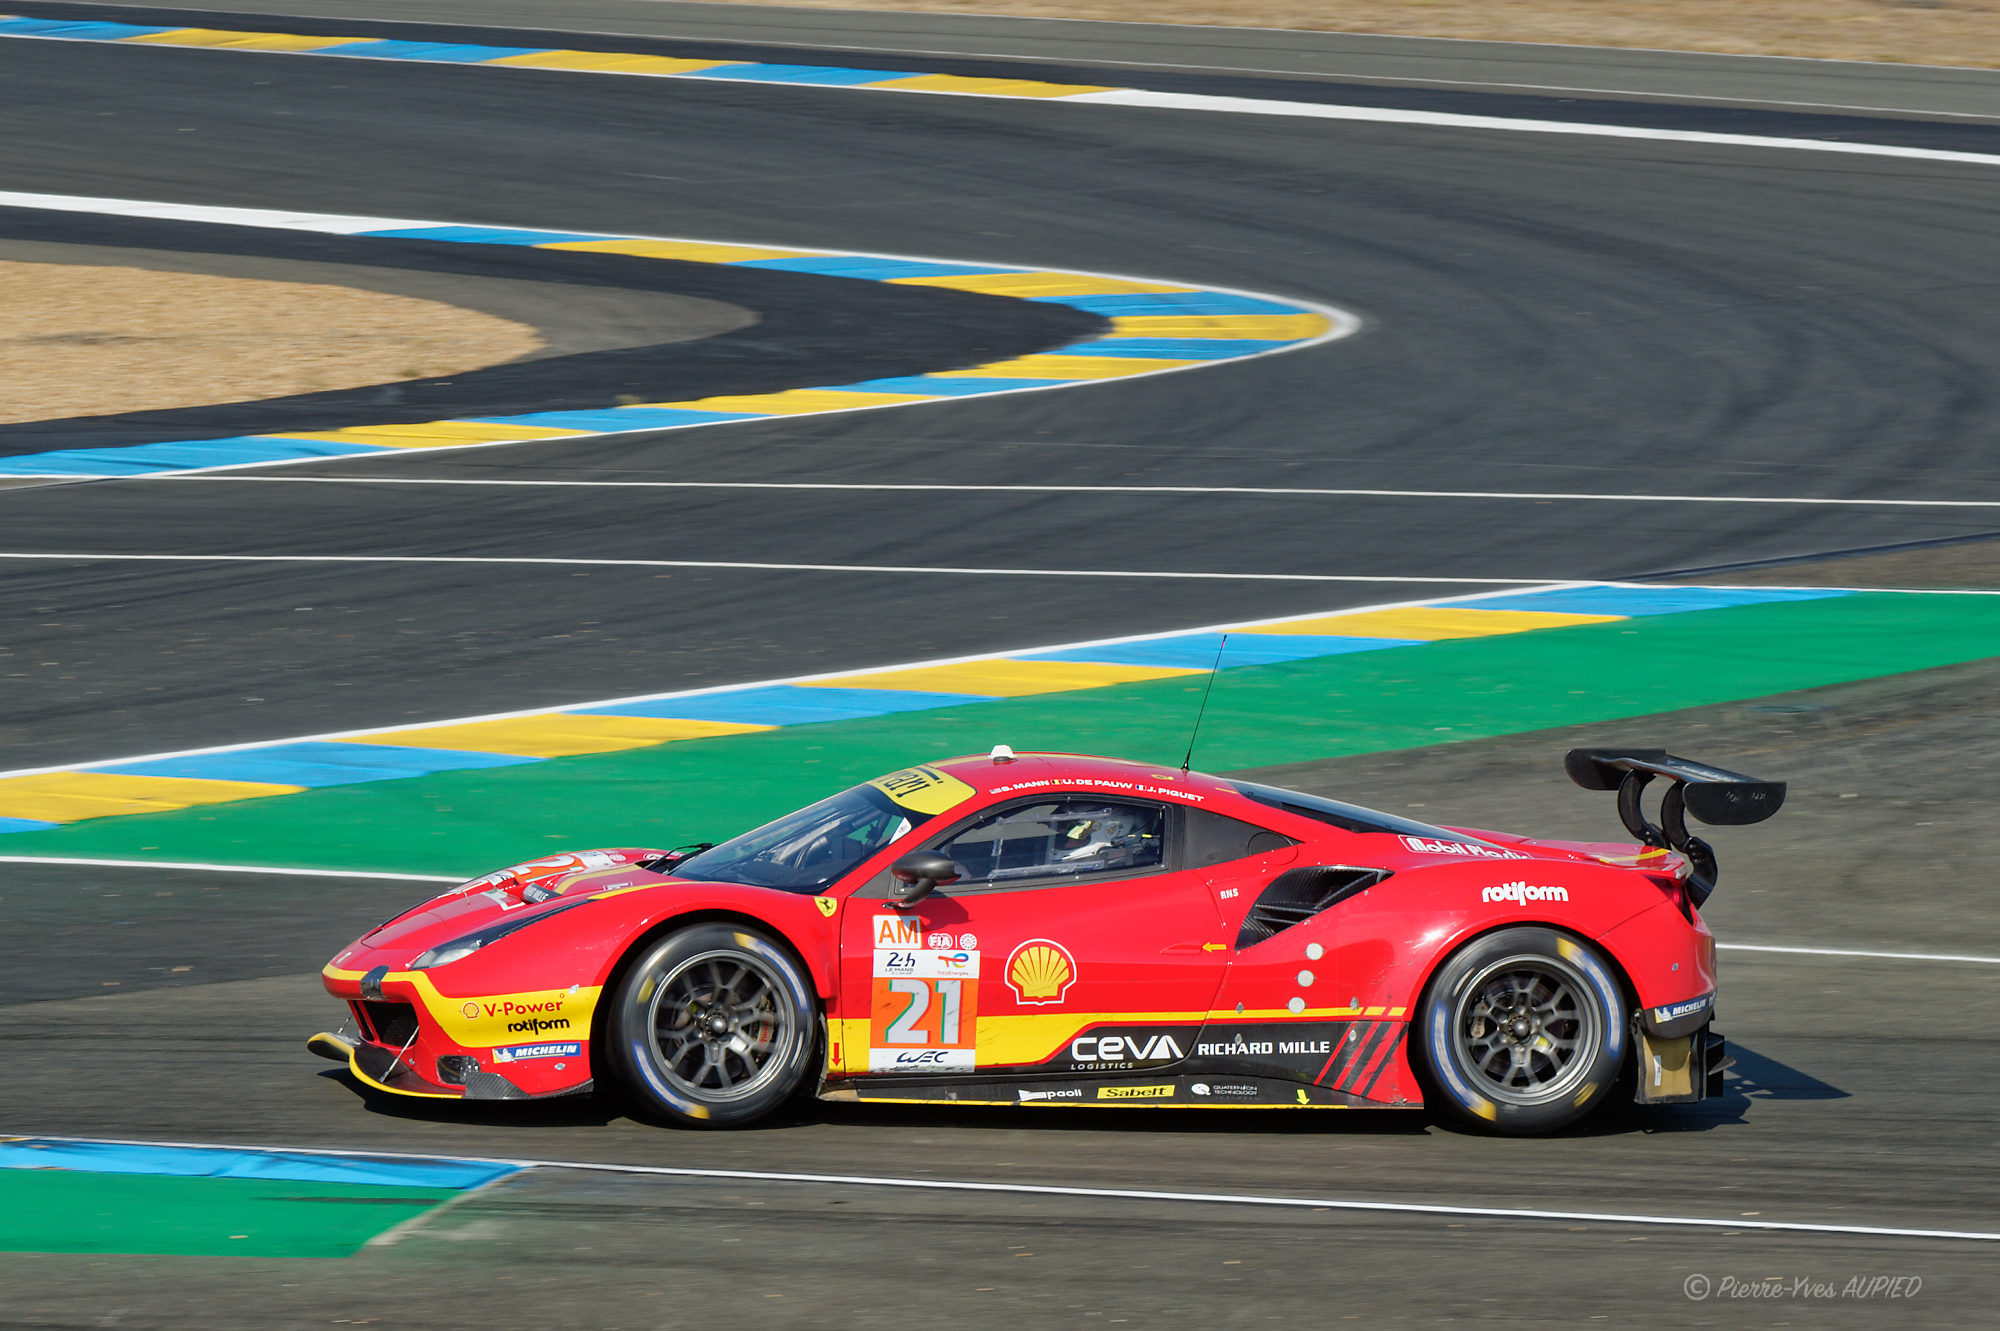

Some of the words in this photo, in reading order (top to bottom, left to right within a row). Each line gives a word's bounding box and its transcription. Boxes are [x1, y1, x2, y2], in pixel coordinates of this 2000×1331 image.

[1013, 779, 1050, 791] MANN
[1094, 779, 1133, 790] PAUW
[1146, 784, 1157, 793] J.
[1158, 787, 1205, 802] PIQUET
[1406, 837, 1468, 855] Mobil
[1220, 888, 1239, 899] RNS
[1482, 881, 1569, 906] rotiform
[879, 919, 918, 944] AM
[483, 1001, 563, 1017] V-Power
[885, 979, 963, 1044] 21
[1672, 999, 1707, 1016] MICHELIN
[507, 1018, 570, 1035] rotiform
[515, 1044, 577, 1057] MICHELIN
[1198, 1042, 1273, 1056] RICHARD
[1279, 1041, 1330, 1054] MILLE
[896, 1050, 949, 1063] WEC
[1070, 1062, 1133, 1071] LOGISTICS
[1106, 1086, 1167, 1097] Sabelt
